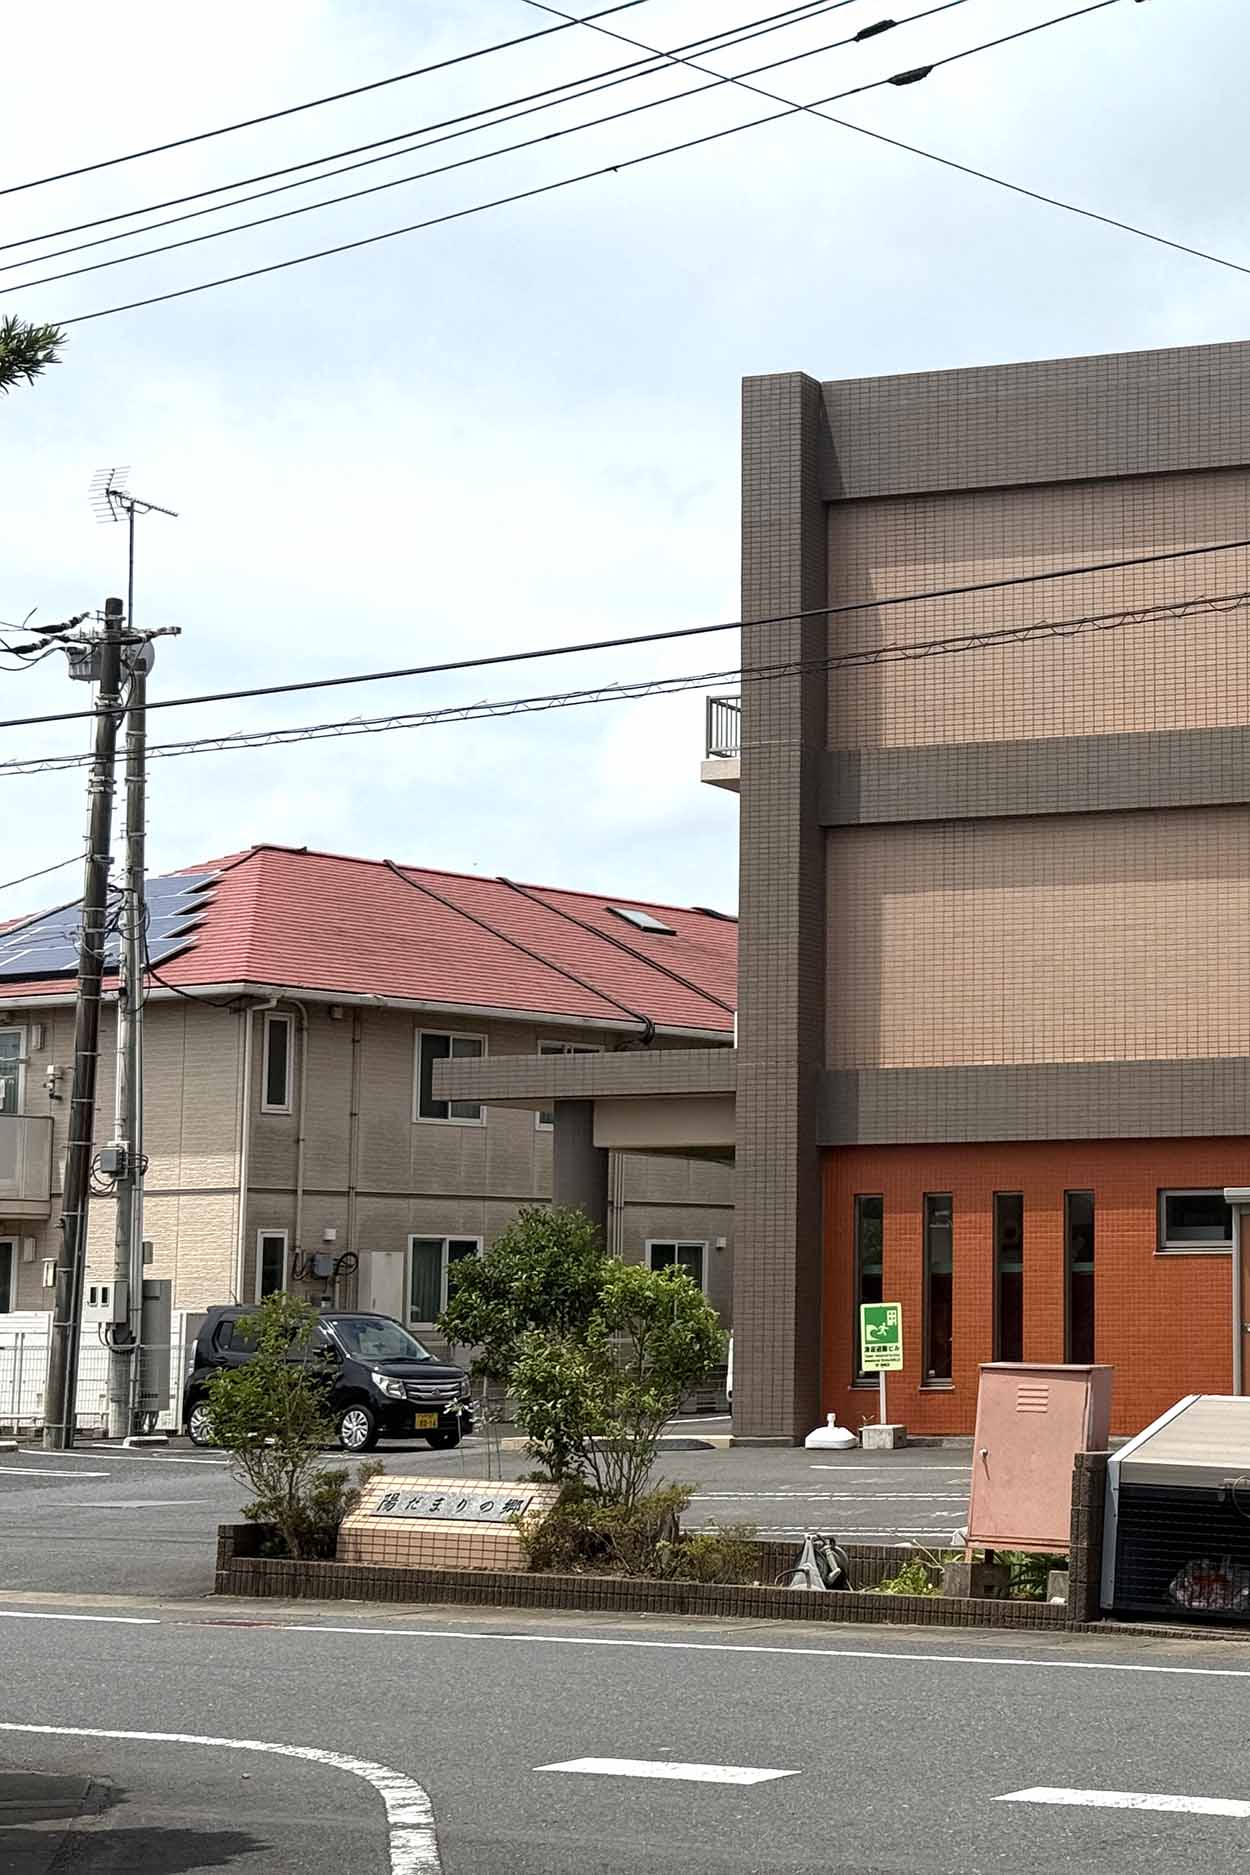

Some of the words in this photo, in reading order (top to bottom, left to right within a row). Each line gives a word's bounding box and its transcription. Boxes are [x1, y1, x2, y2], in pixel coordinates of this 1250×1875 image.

[377, 1492, 525, 1514] 陽だまりの郷
